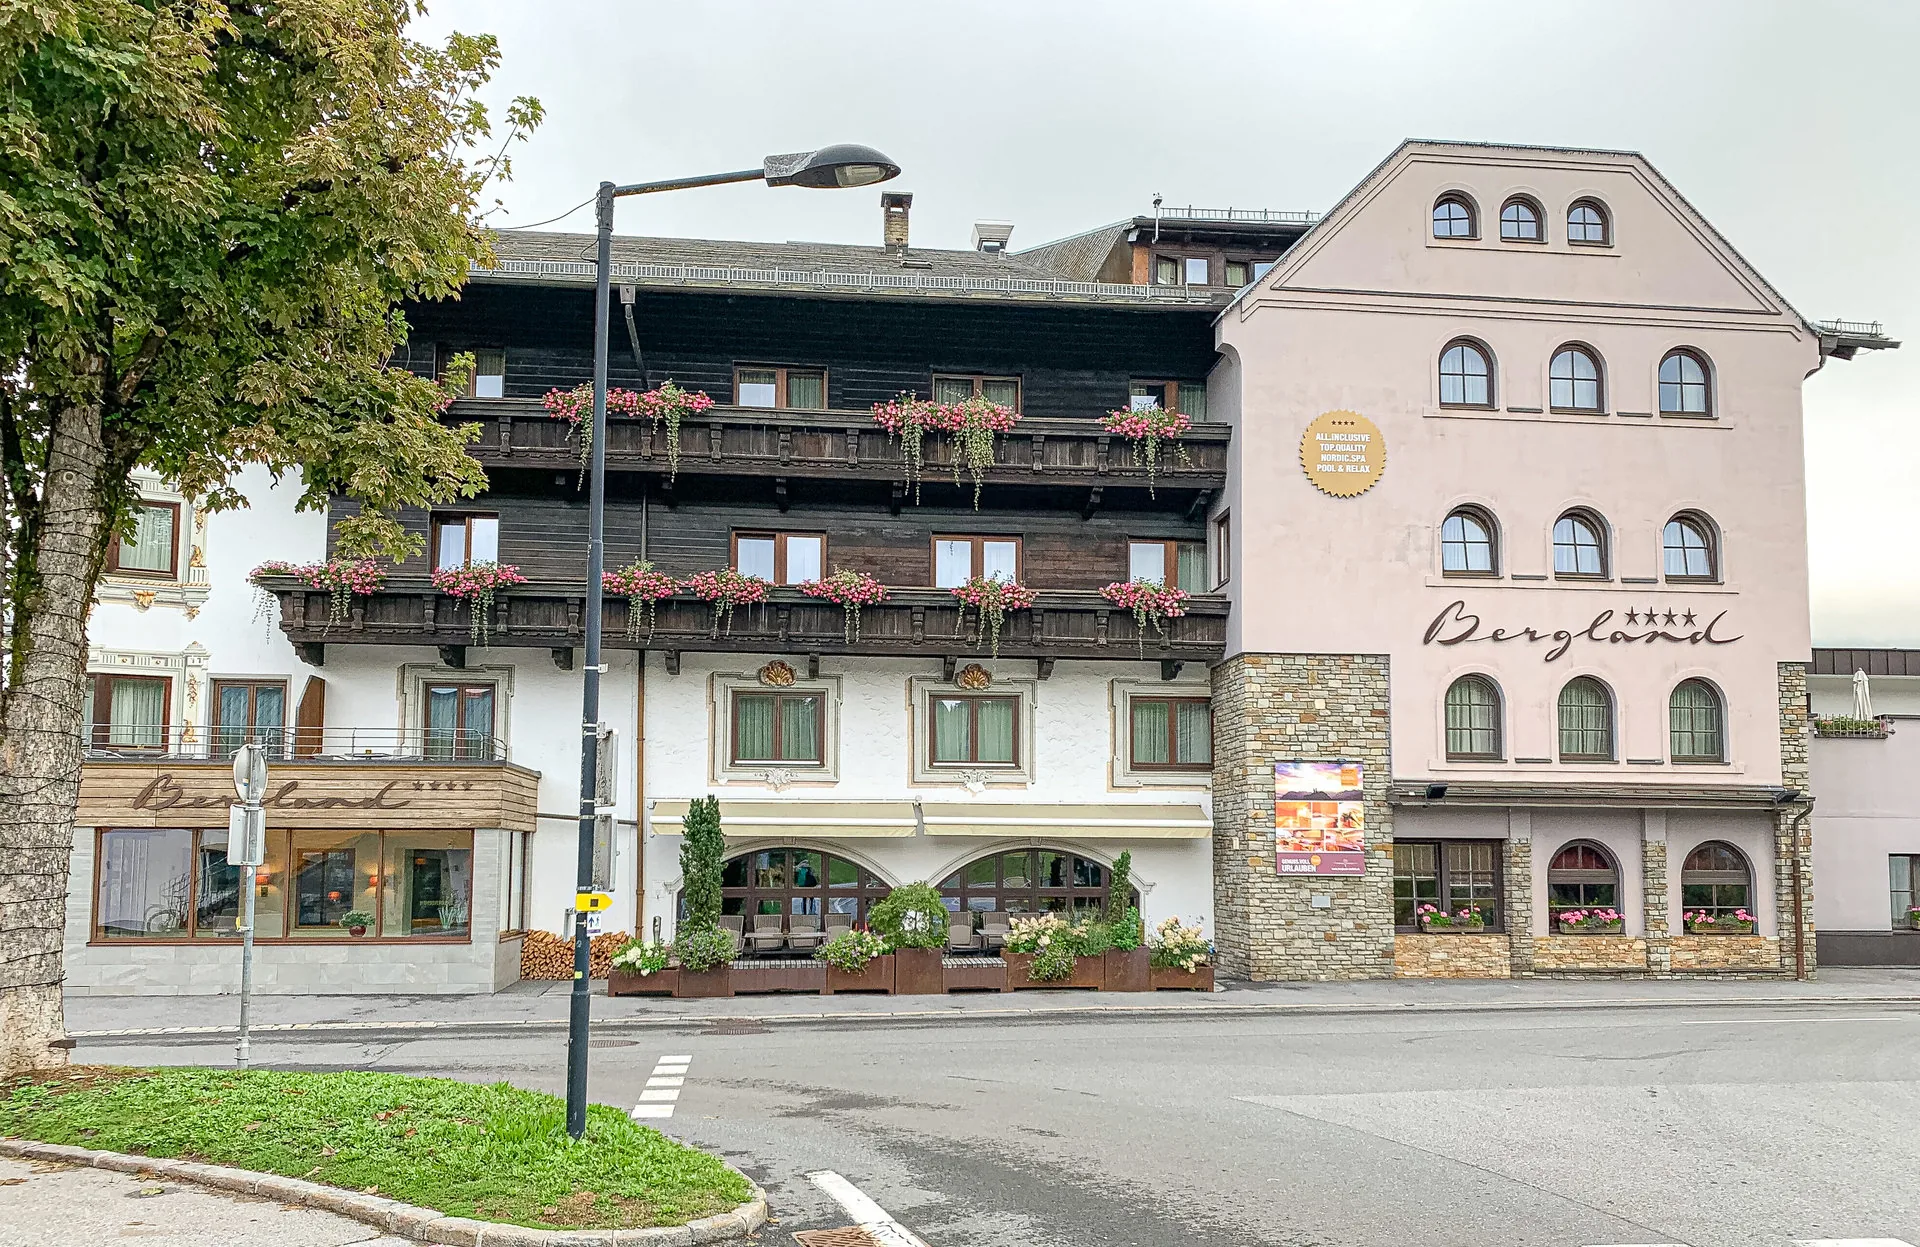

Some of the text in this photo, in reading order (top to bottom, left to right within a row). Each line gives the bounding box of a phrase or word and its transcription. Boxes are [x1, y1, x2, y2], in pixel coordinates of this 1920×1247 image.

[1315, 432, 1371, 442] ALL.INCLUSIVE
[1319, 443, 1367, 452] TOP.QUALITY
[1320, 453, 1366, 463] NORDIC.SPA
[1316, 464, 1371, 473] POOL & RELAX
[1423, 600, 1744, 663] Bergland
[132, 773, 411, 810] Berland
[1281, 864, 1317, 873] URLAUBEN
